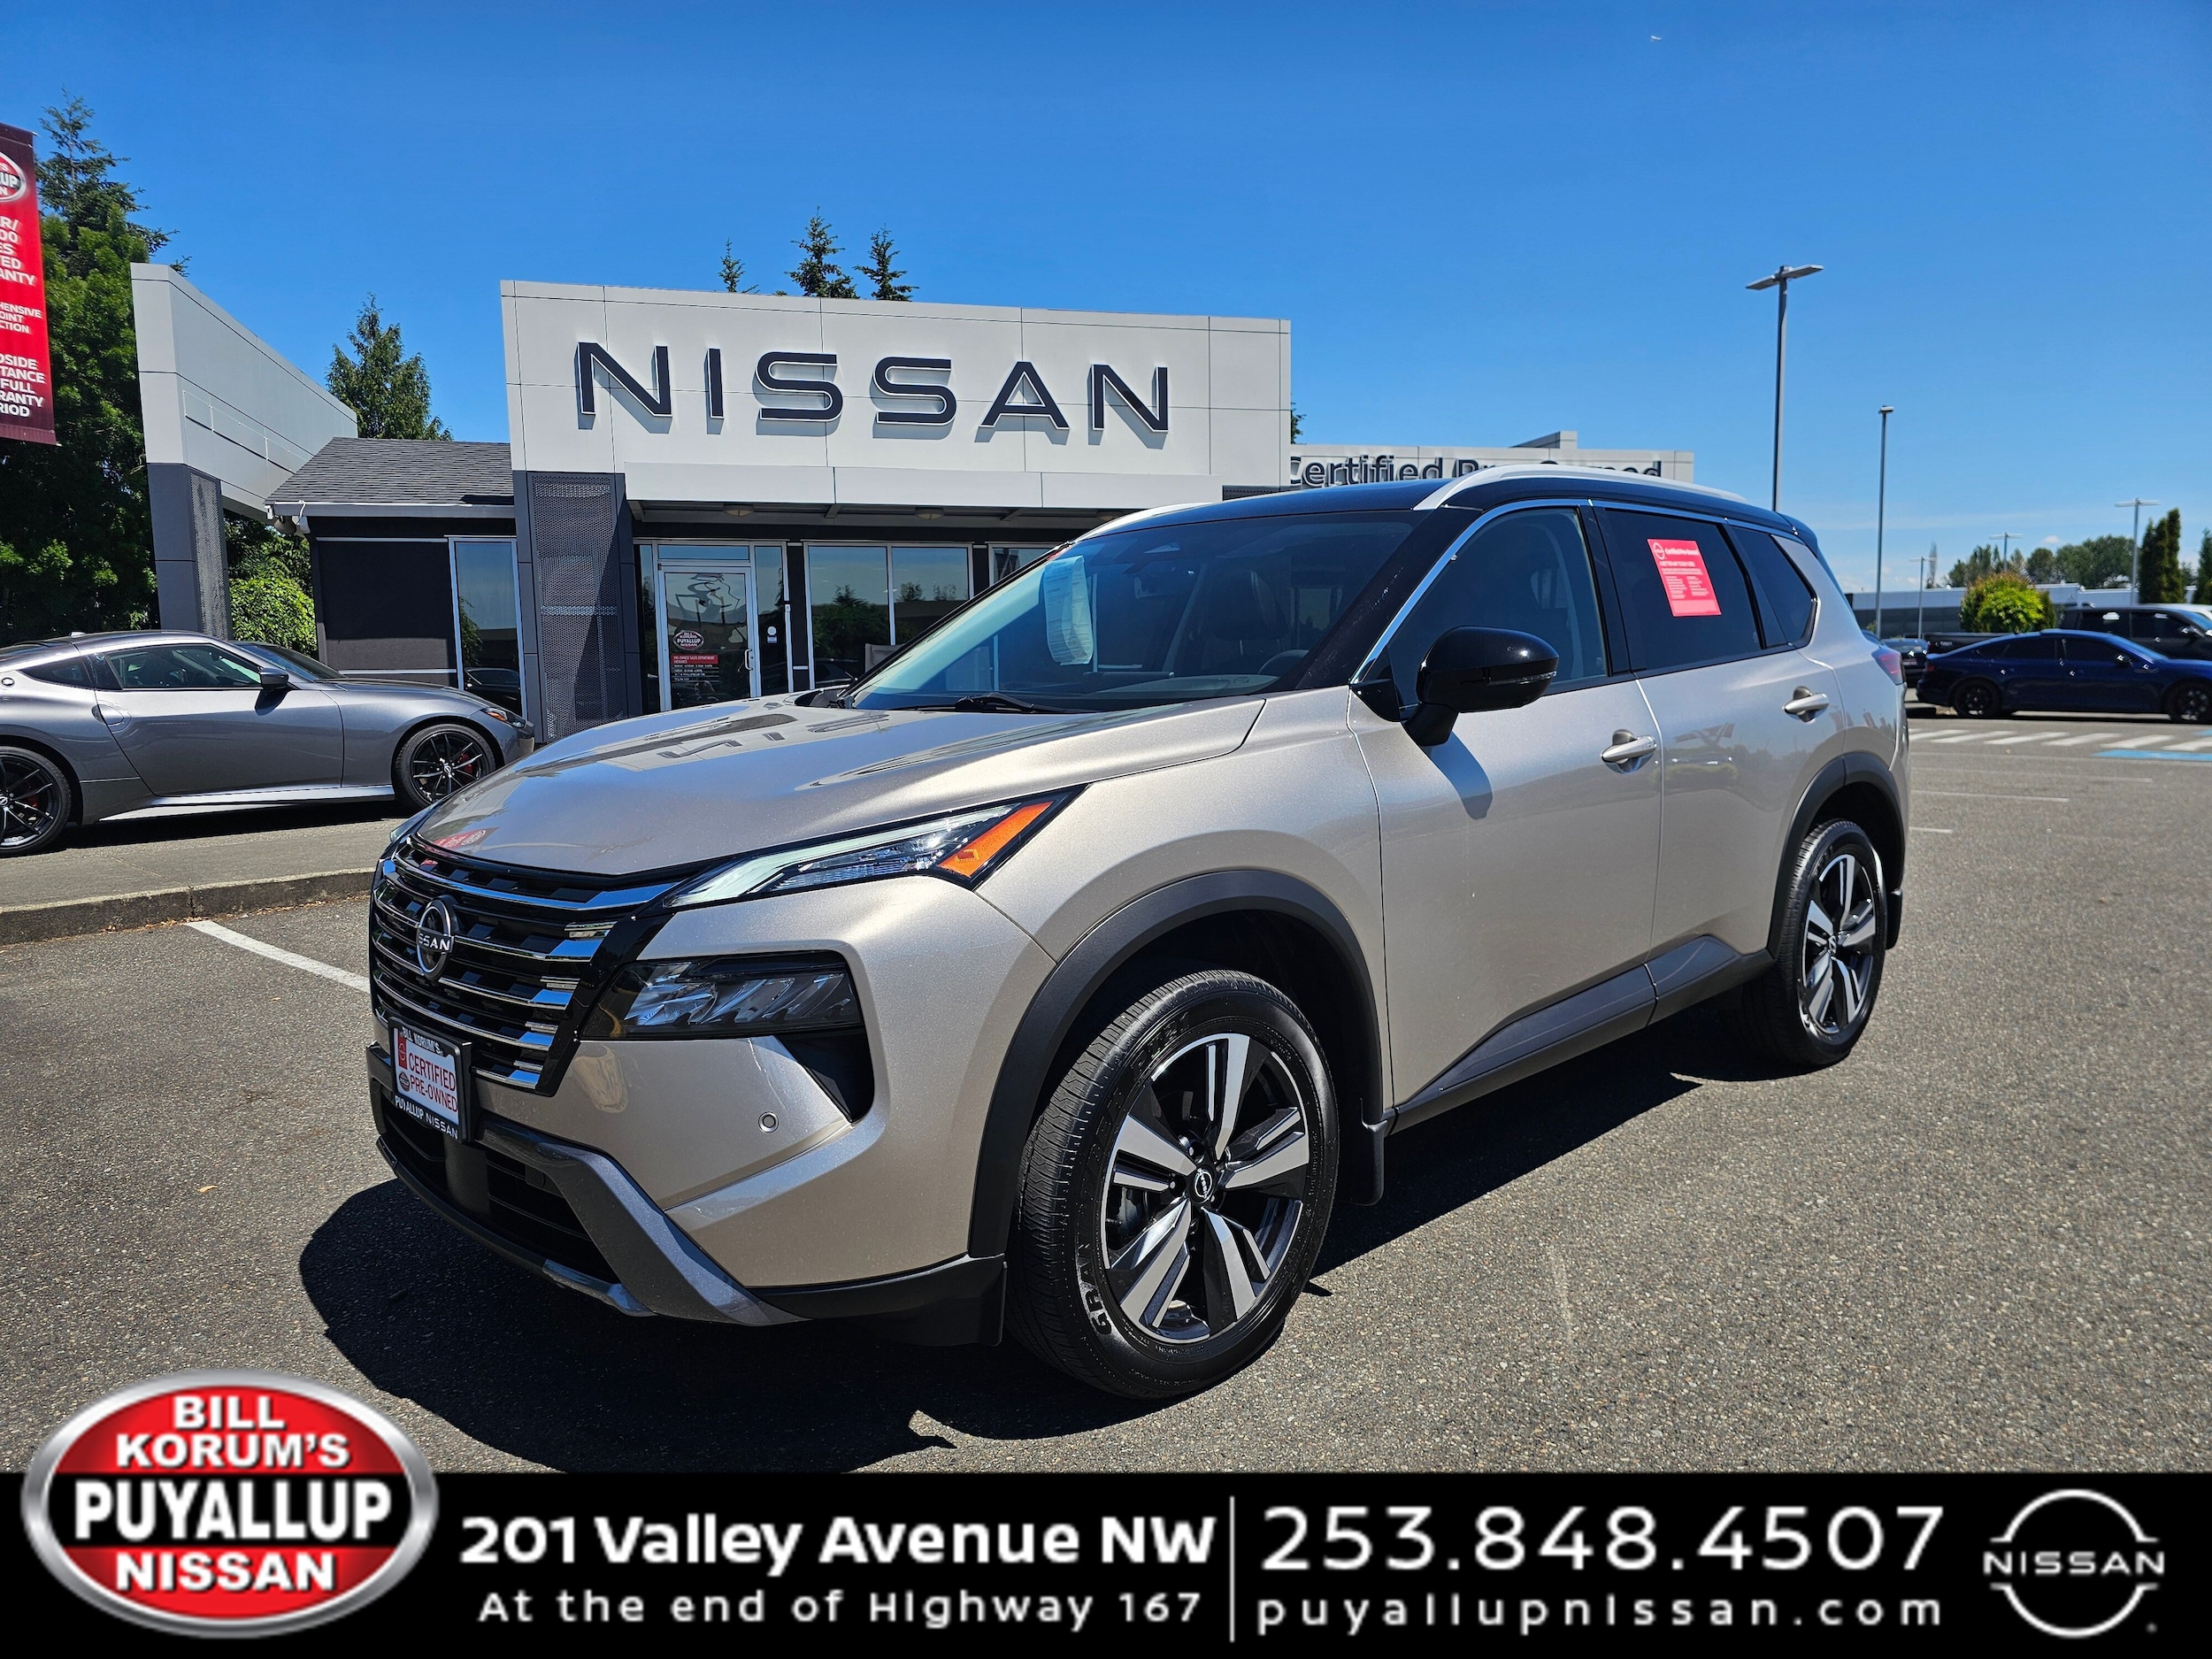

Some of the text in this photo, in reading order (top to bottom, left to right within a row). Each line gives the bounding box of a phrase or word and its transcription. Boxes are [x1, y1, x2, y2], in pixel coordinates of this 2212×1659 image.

[1, 379, 35, 394] FULL
[576, 341, 1171, 434] NISSAN
[419, 933, 450, 951] SSAN
[409, 1052, 457, 1092] CERTIFIED
[410, 1075, 457, 1112] PRE-OWNED
[426, 1112, 458, 1141] NISSAN
